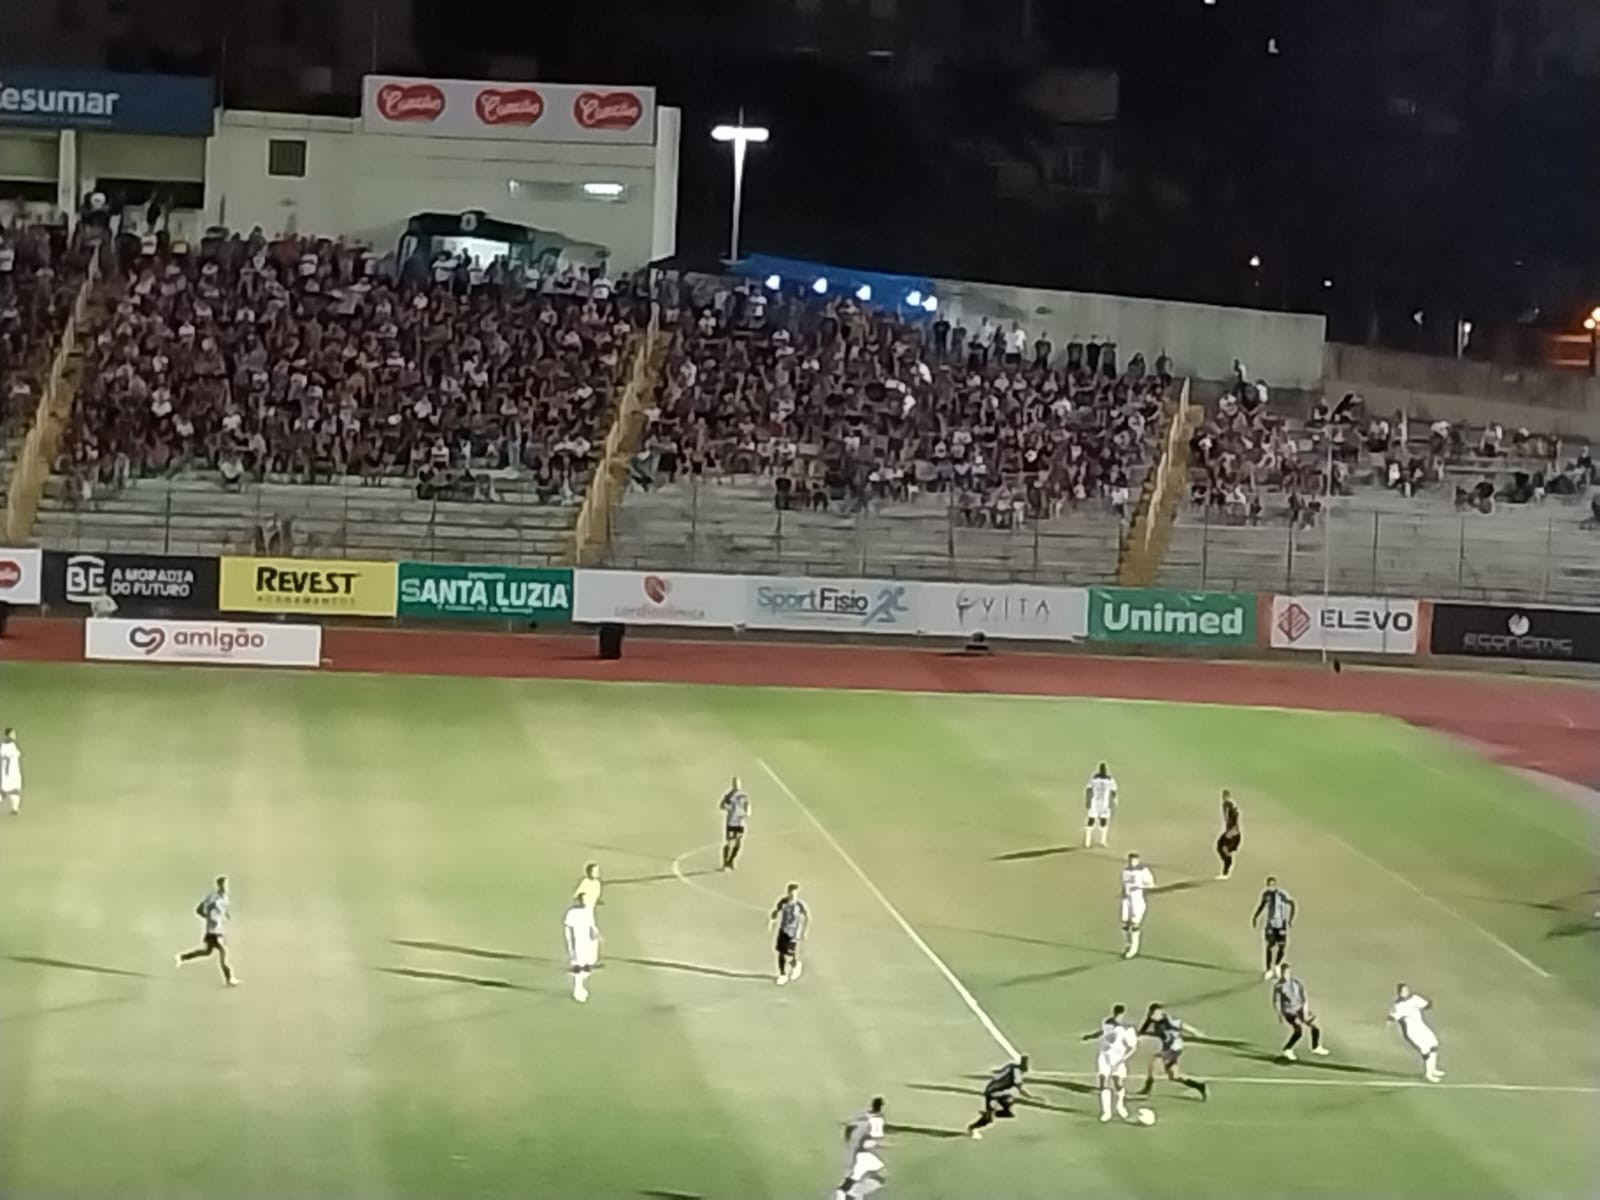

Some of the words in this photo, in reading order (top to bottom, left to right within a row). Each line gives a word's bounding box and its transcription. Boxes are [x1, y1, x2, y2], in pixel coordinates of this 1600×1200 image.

[0, 82, 119, 115] esumar
[111, 582, 131, 595] DO
[134, 583, 190, 597] FUTURO
[256, 566, 361, 594] REVEST
[401, 577, 488, 605] SANTA
[496, 582, 569, 609] LUZIA
[1104, 602, 1243, 635] Unimed
[1320, 609, 1413, 632] ELEVO
[174, 627, 264, 651] amigão
